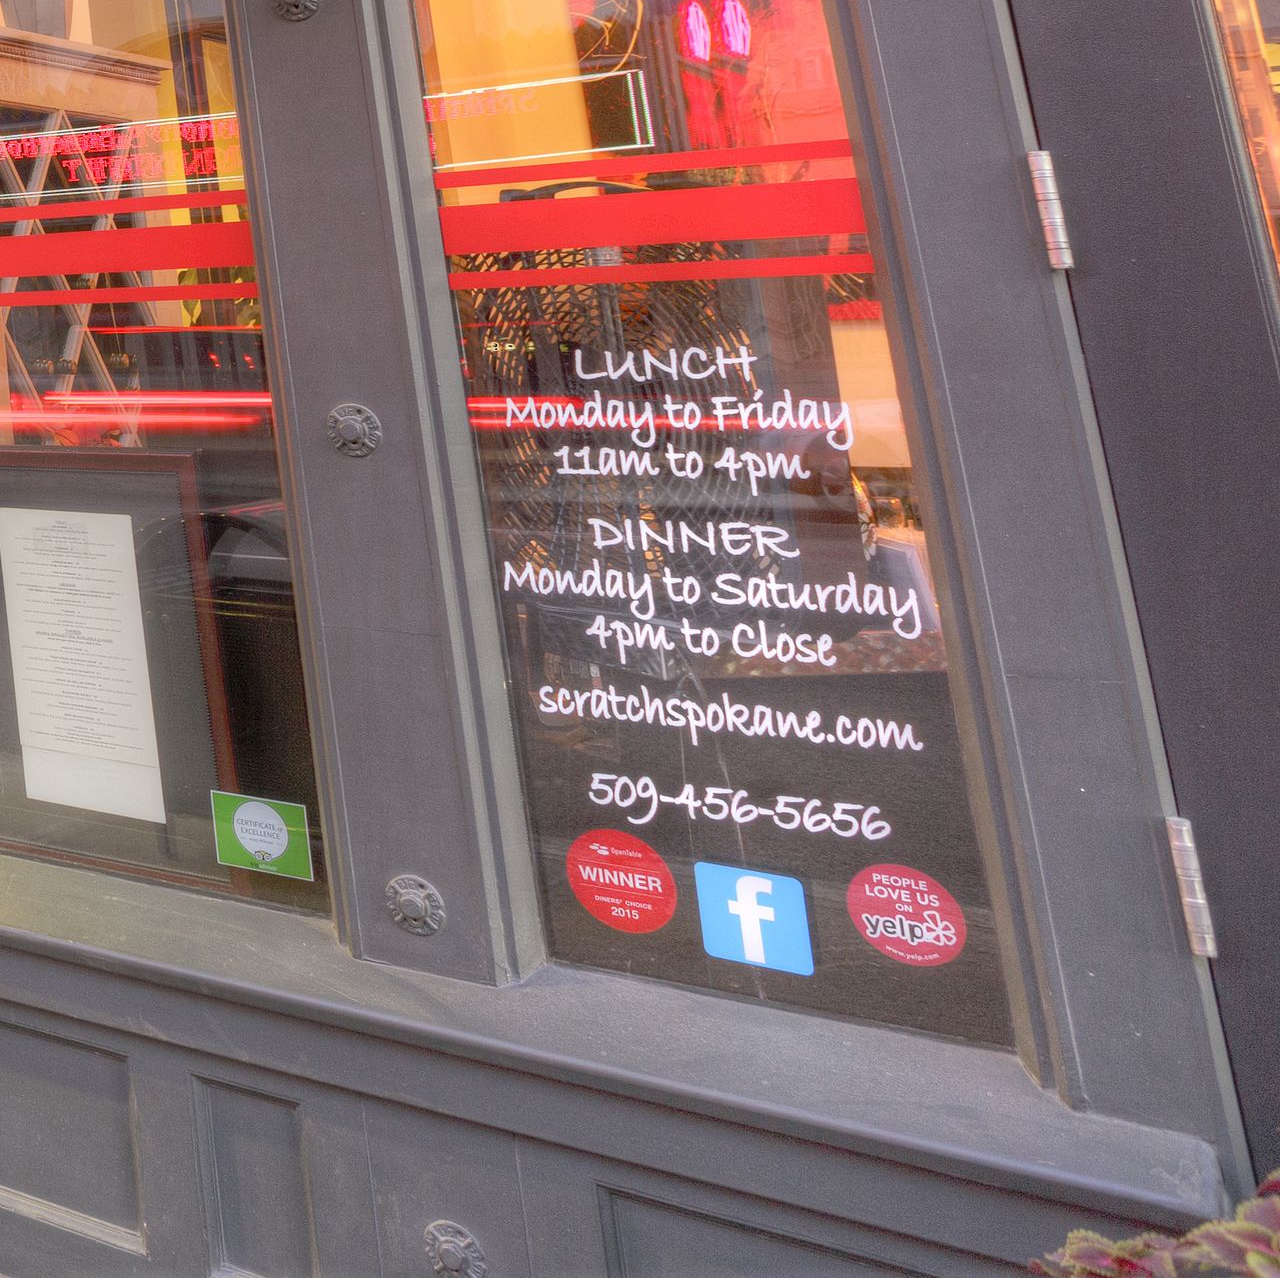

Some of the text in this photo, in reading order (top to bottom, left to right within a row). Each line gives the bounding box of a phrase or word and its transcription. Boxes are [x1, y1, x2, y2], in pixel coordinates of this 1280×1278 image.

[574, 346, 758, 382] LUNCH
[505, 389, 854, 451] Monday to Friday
[553, 442, 811, 497] 11am to 4pm
[587, 518, 800, 559] DINNER
[503, 558, 922, 639] Monday to Saturday
[585, 615, 838, 667] 4pm to Close
[539, 685, 924, 751] scratchspokane.com
[588, 773, 892, 841] 509-456-5656
[236, 818, 277, 831] CERTIFICATE
[240, 827, 281, 840] EXCELLENCE
[610, 847, 642, 858] OpenTable
[578, 864, 663, 893] WINNER
[872, 873, 928, 891] PEOPLE
[624, 900, 653, 910] CHOICE
[864, 884, 940, 907] LOVE US
[895, 903, 913, 913] ON
[610, 906, 640, 920] 2015
[863, 914, 924, 945] yelp
[885, 945, 940, 961] www.yelp.com
